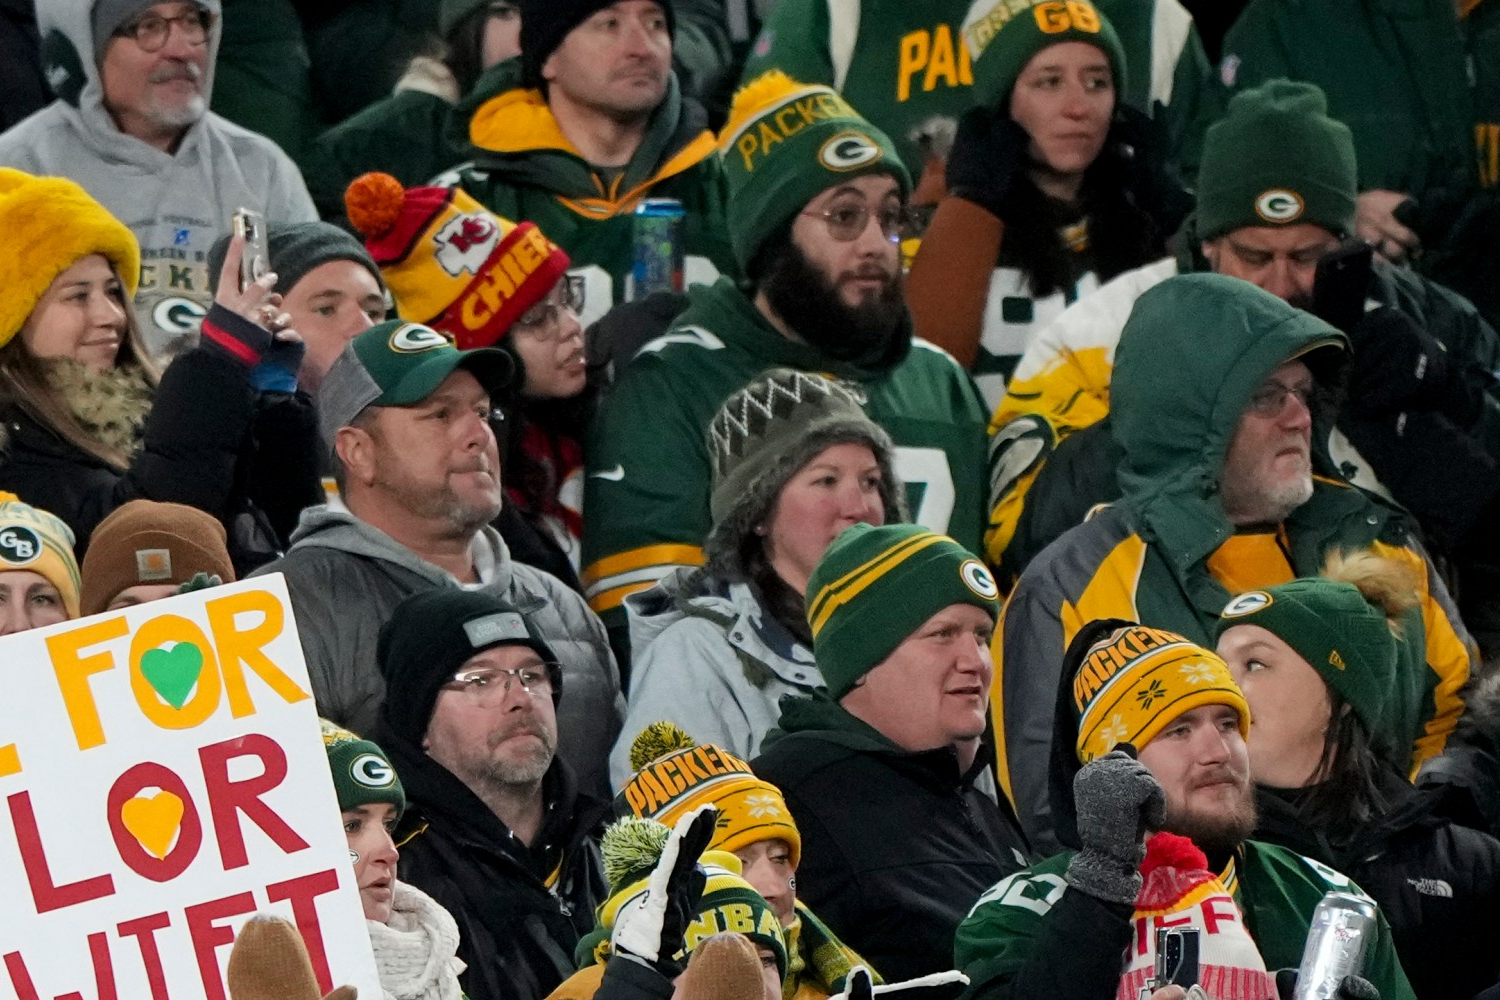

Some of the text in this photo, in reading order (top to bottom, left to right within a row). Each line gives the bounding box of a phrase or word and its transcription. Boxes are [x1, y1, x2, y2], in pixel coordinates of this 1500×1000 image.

[1030, 3, 1097, 34] GB
[824, 139, 879, 167] G
[1257, 190, 1301, 220] G
[154, 298, 207, 333] G
[393, 322, 448, 350] G
[0, 531, 33, 557] GB
[963, 561, 998, 598] G
[46, 590, 310, 751] FOR
[352, 756, 395, 785] G
[682, 902, 783, 950] NBA
